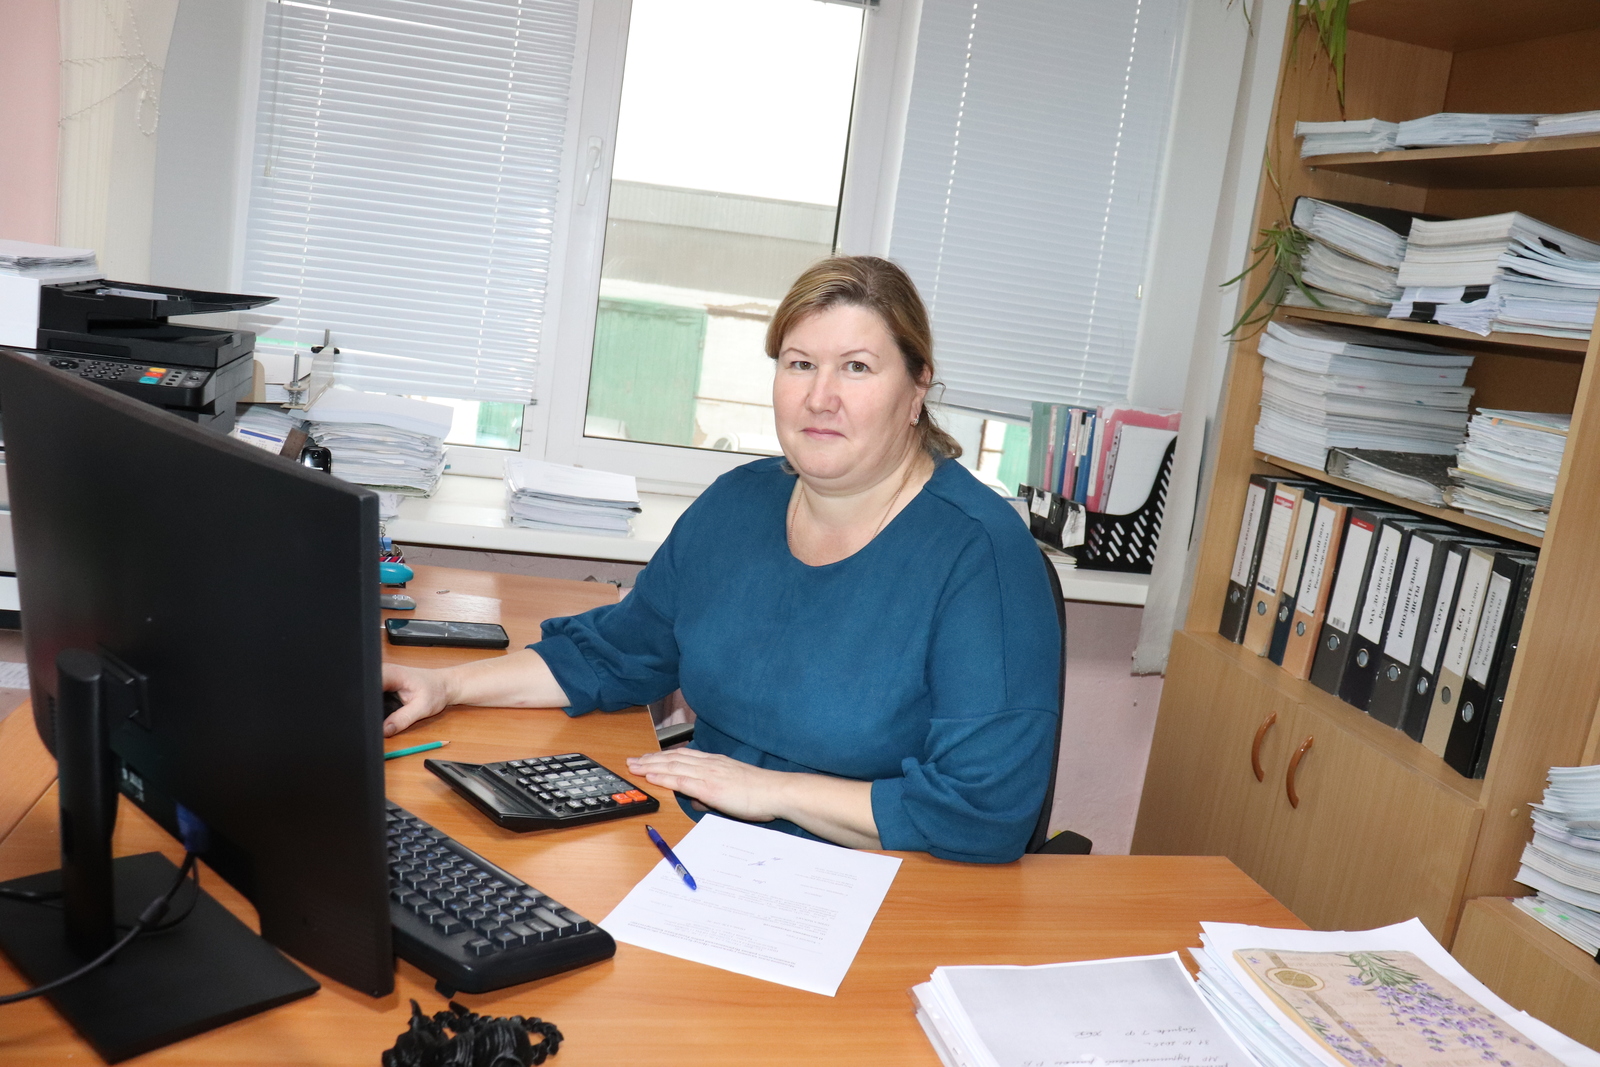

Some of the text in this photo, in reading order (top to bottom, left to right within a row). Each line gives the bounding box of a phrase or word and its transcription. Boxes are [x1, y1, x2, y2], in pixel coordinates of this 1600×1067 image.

[1313, 531, 1330, 589] Расчет зарплаты
[1377, 557, 1395, 620] Расчет зарплаты
[1396, 554, 1420, 639] ИСПОЛНИТЕЛЬНЫЕ
[1409, 584, 1421, 617] ЛИСТЫ
[1433, 599, 1445, 634] РАДУГА
[1486, 590, 1496, 614] СОШ
[1480, 597, 1503, 666] Расчет зарплаты
